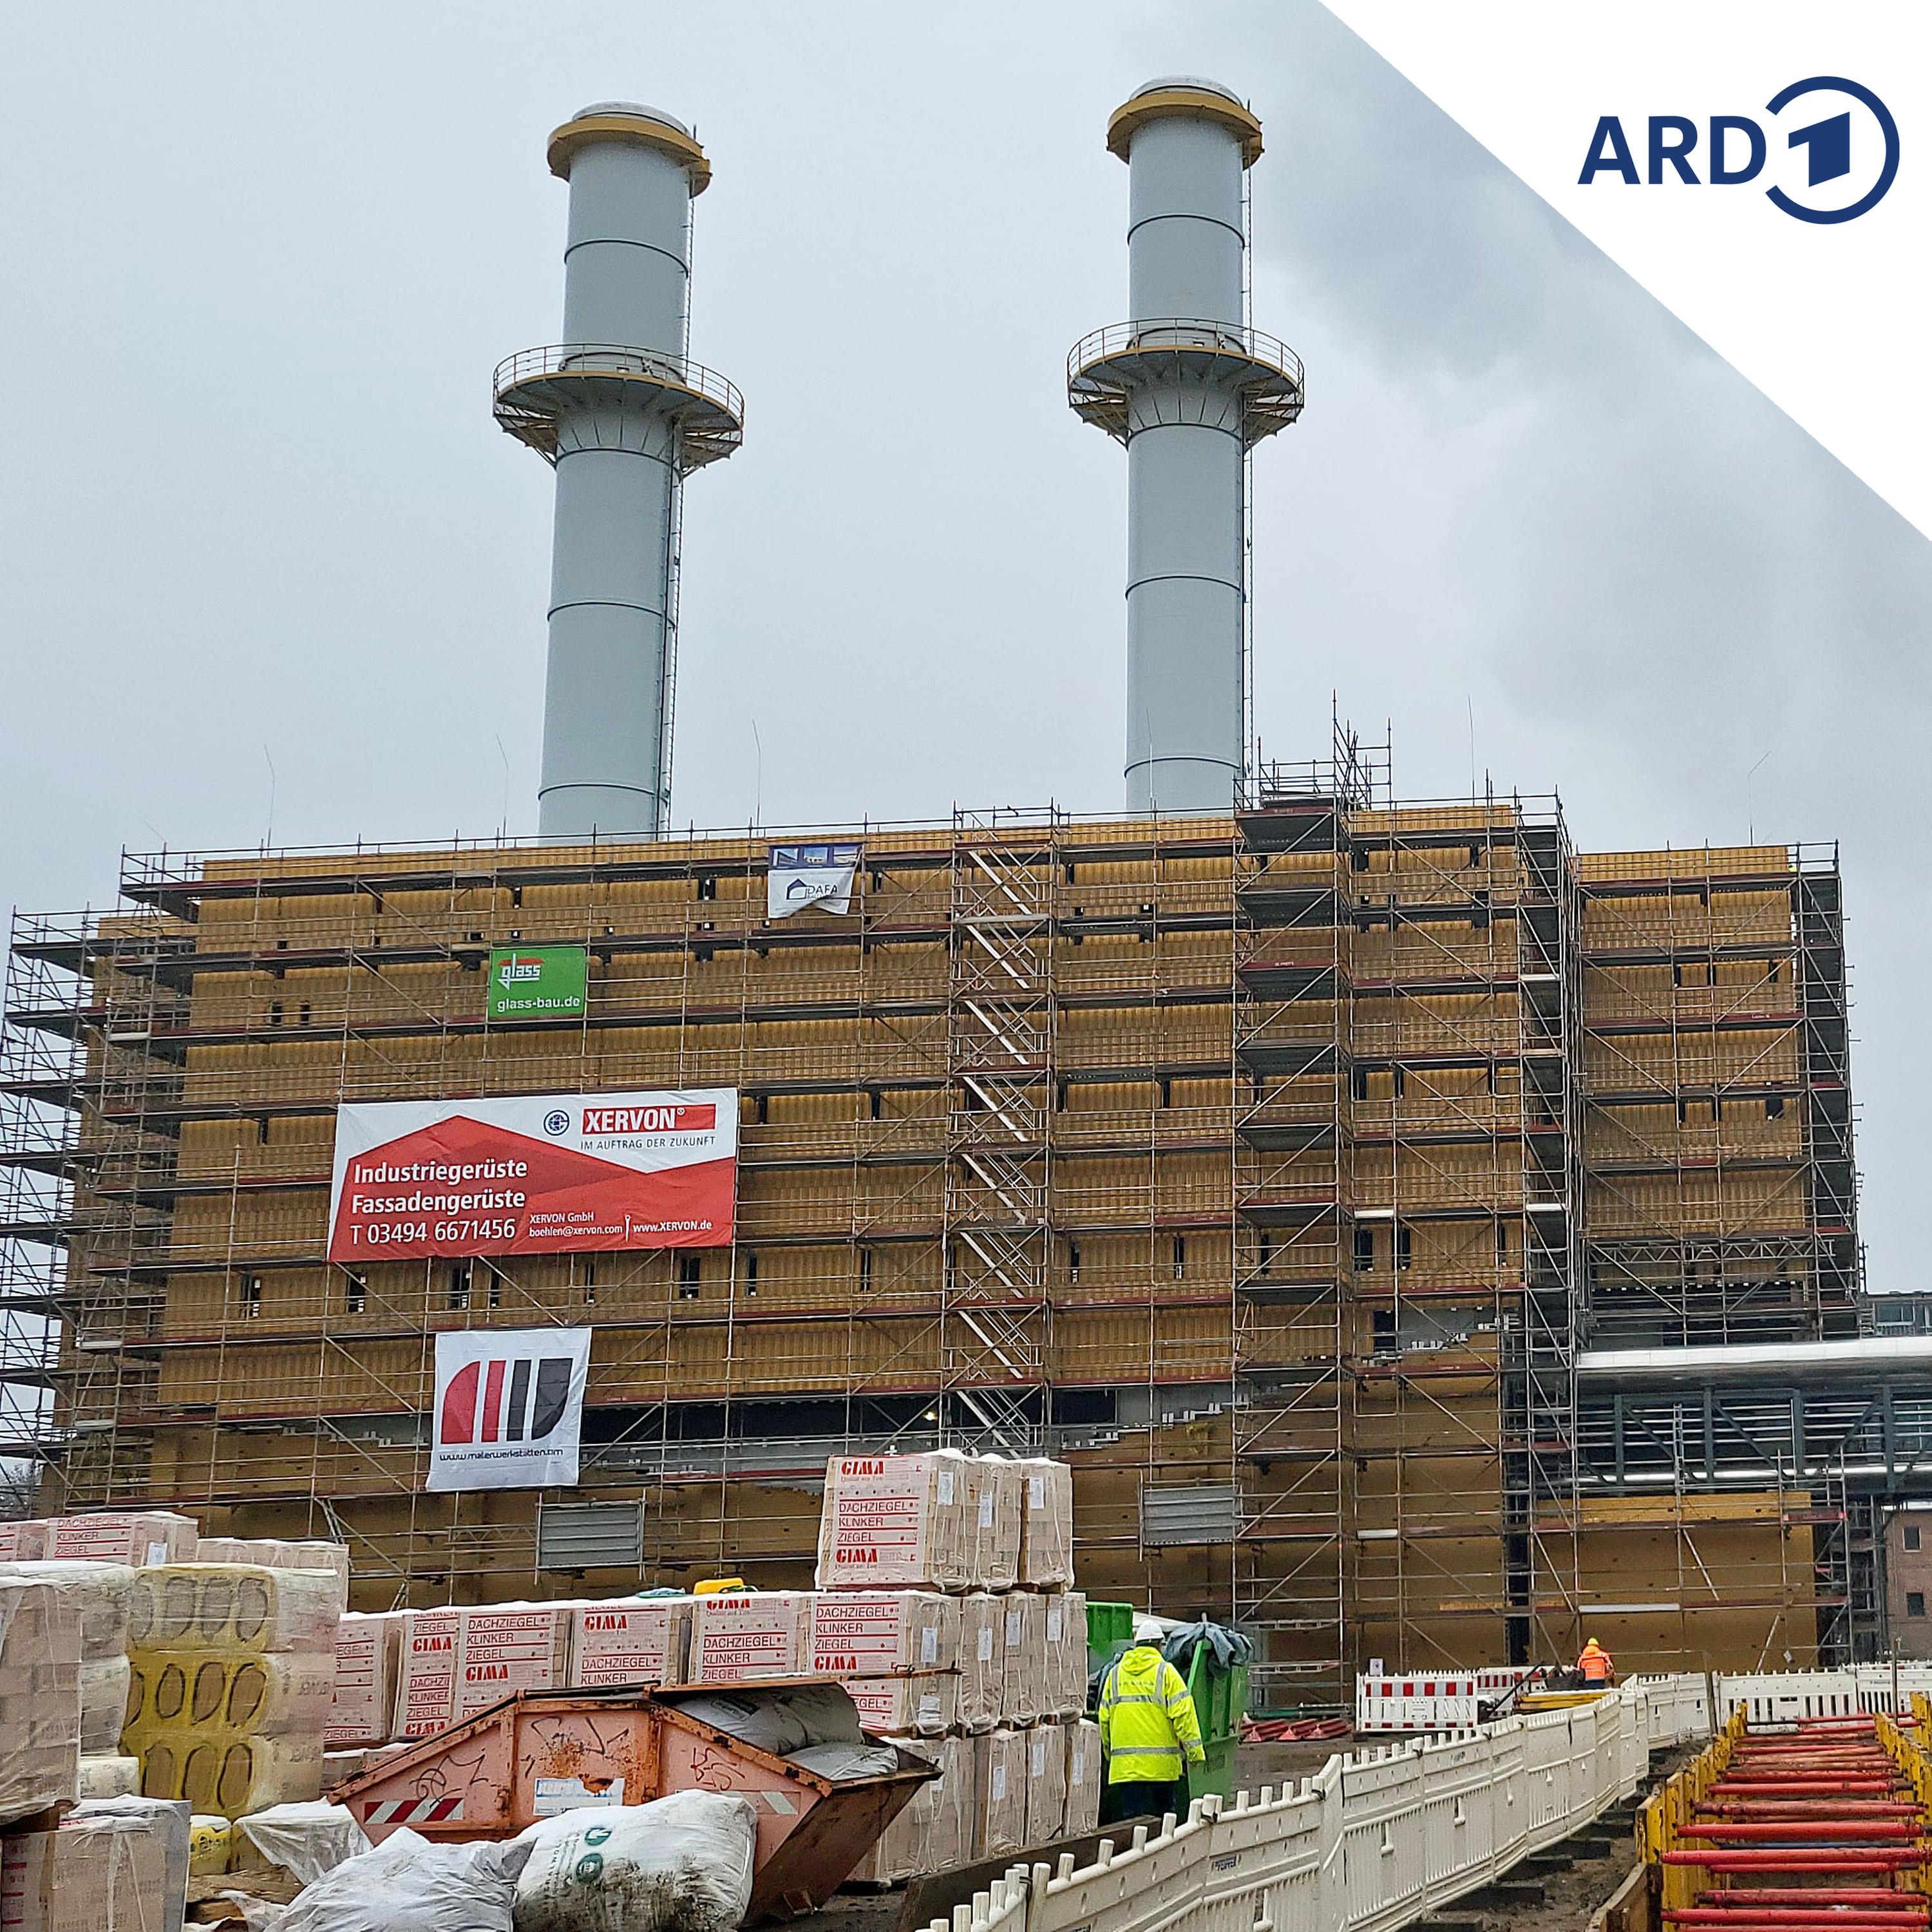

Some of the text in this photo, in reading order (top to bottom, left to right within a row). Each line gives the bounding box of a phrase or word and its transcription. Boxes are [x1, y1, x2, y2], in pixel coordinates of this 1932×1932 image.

[497, 953, 541, 990] glass
[497, 996, 580, 1012] glass-bau.de
[581, 1136, 716, 1150] IM AUFTRAG DER ZUKUNFT
[354, 1159, 527, 1186] Industriegerüste
[352, 1189, 526, 1215] Fassadengerüste
[529, 1211, 594, 1224] XERVON GmbH
[350, 1218, 515, 1245] T 03494 6671456
[529, 1225, 623, 1238] boehlen@xervon.com
[633, 1220, 712, 1233] www.XERVON.de
[839, 1501, 908, 1513] DACHZIEGEL
[57, 1531, 99, 1541] KLINKER
[837, 1532, 875, 1542] ZIEGEL
[816, 1607, 889, 1618] DACHZIEGEL
[413, 1622, 449, 1633] ZIEGEL
[468, 1617, 540, 1630] DACHZIEGEL
[815, 1623, 864, 1634] KLINKER
[467, 1633, 515, 1645] KLINKER
[703, 1636, 775, 1649] DACHZIEGEL
[815, 1638, 854, 1650] ZIEGEL
[466, 1649, 506, 1661] ZIEGEL
[702, 1653, 750, 1664] KLINKER
[582, 1657, 651, 1669] DACHZIEGEL
[581, 1673, 627, 1685] KLINKER
[701, 1669, 741, 1680] ZIEGEL
[406, 1707, 443, 1718] ZIEGEL
